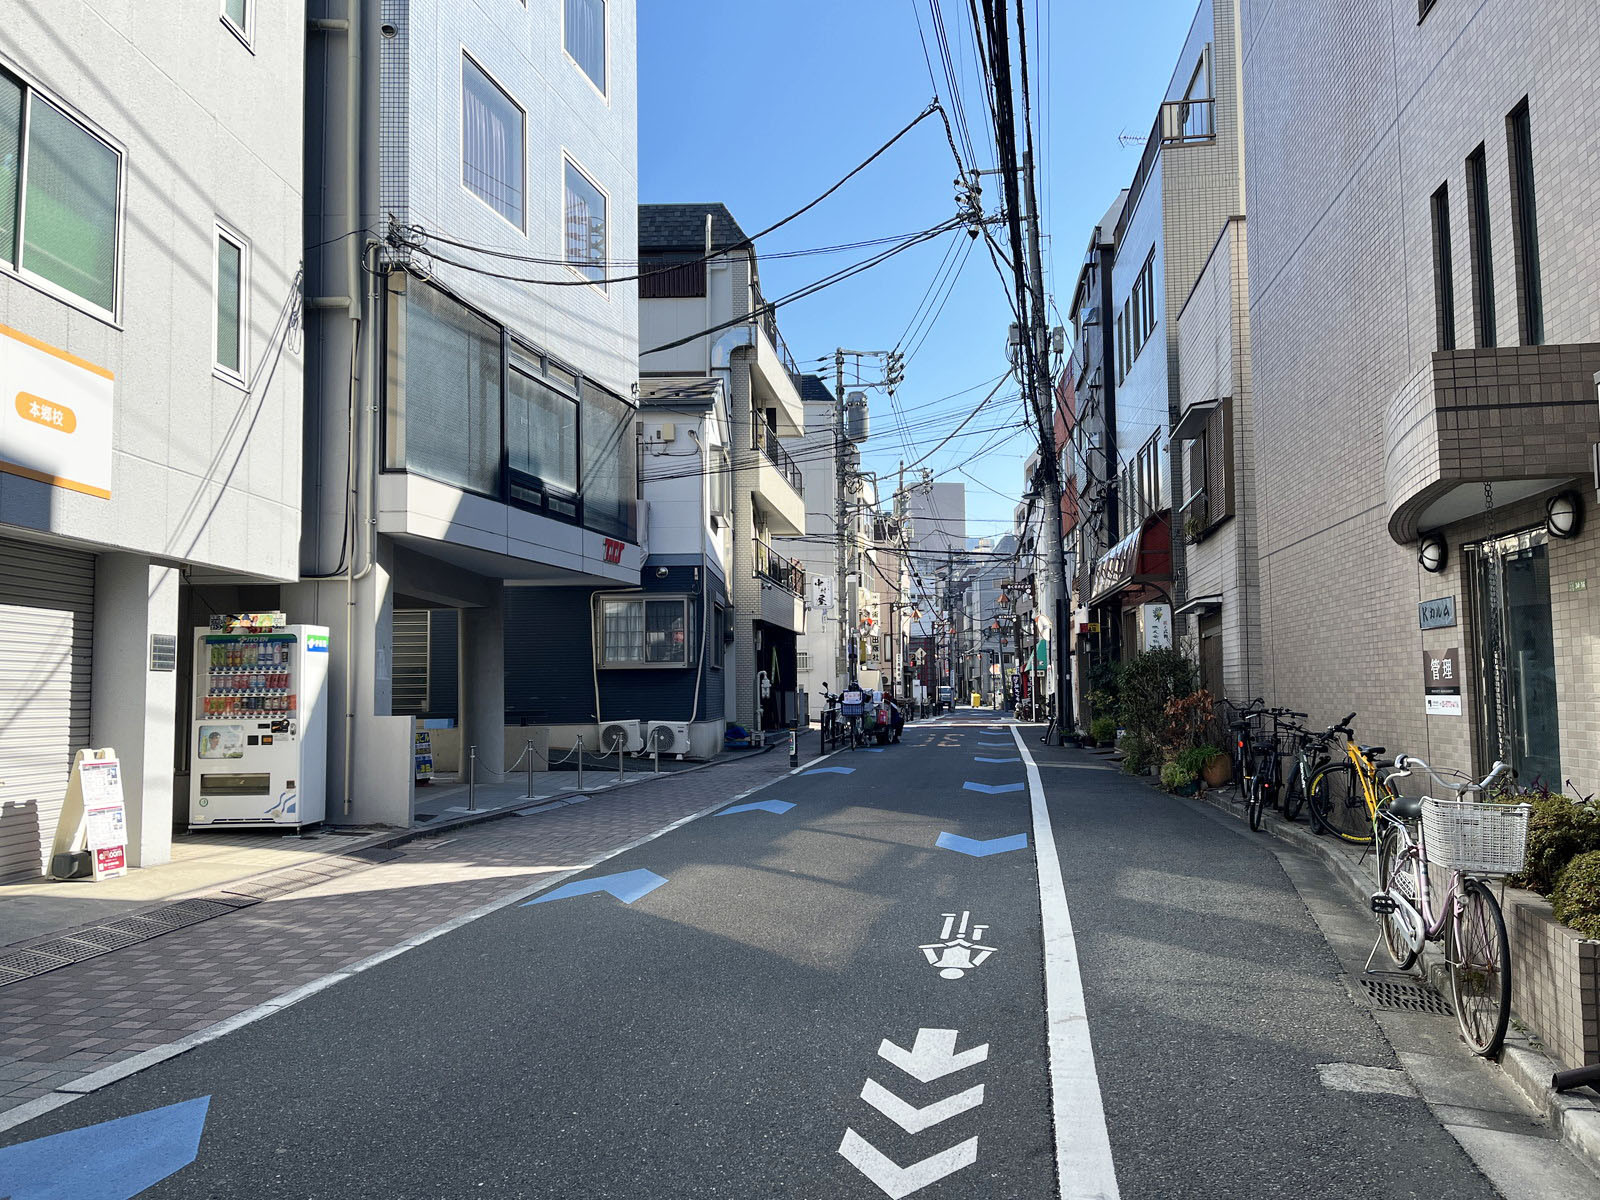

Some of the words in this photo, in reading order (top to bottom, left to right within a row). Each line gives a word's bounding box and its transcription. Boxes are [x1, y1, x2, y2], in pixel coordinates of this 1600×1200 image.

[29, 400, 64, 426] 本郷校
[1431, 658, 1453, 680] 管理
